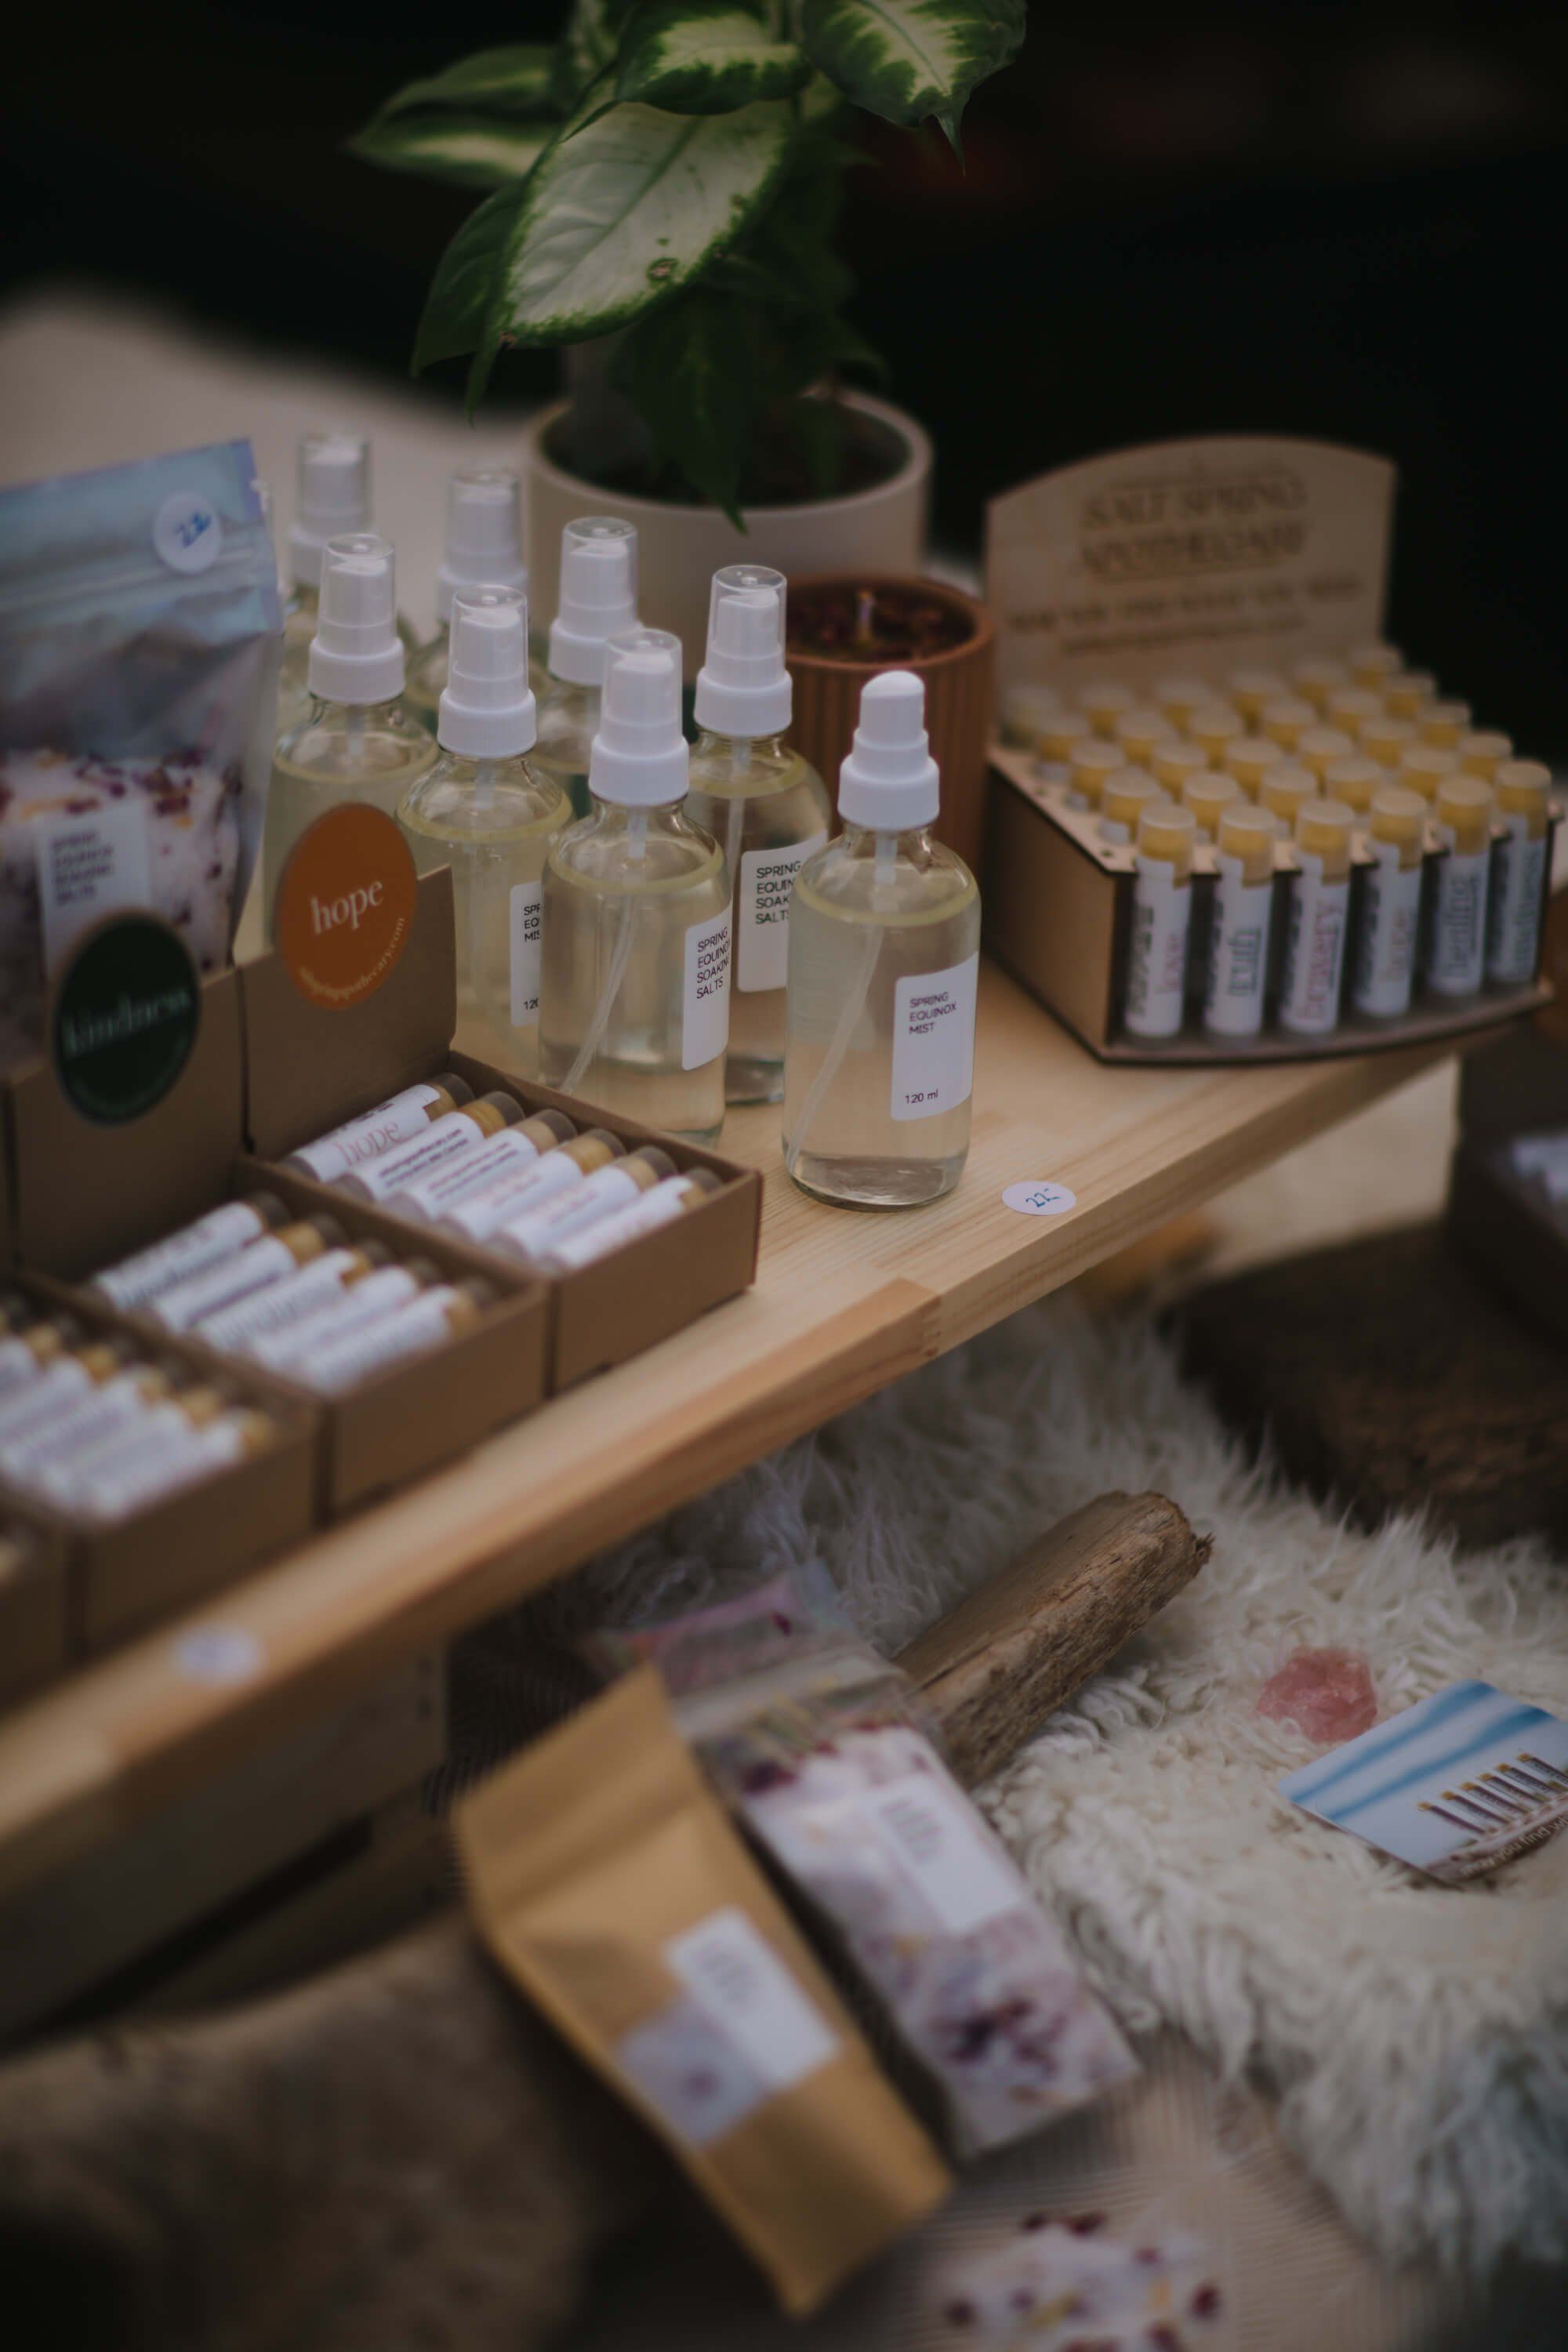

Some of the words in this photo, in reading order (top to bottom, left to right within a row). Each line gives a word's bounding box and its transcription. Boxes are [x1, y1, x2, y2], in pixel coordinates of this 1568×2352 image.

[757, 860, 800, 879] SPRING
[309, 880, 384, 935] hope
[697, 927, 728, 953] SPRING
[696, 976, 724, 1000] SALTS
[909, 992, 949, 1009] SPRING
[909, 1002, 957, 1022] EQUINOX
[909, 1022, 935, 1035] MIST
[905, 1092, 924, 1105] 120
[927, 1089, 938, 1100] ml
